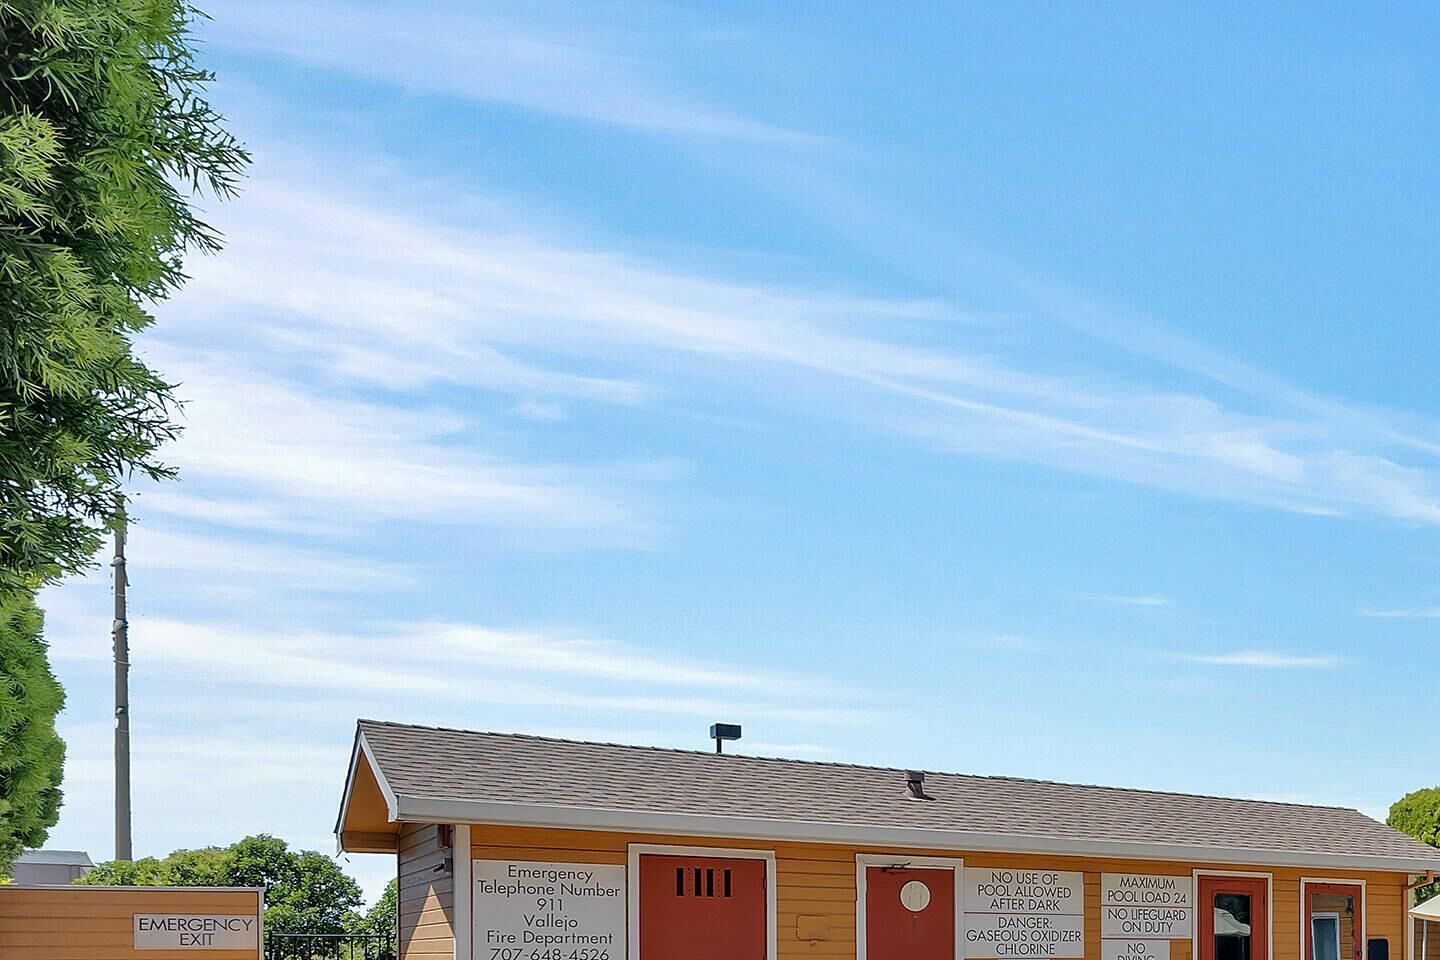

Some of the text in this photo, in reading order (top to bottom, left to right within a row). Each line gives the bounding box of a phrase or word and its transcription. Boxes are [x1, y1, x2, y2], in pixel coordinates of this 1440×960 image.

[508, 864, 593, 883] Emergency
[991, 872, 1058, 885] NO USE OF
[478, 880, 621, 897] Telephone Number
[1120, 877, 1175, 889] MAXIMUM
[978, 885, 1071, 898] POOL ALLOWED
[1108, 891, 1186, 903] POOL LOAD 24
[536, 898, 563, 911] 911
[990, 899, 1060, 911] AFTER DARK
[1108, 909, 1186, 921] NO LIFEGUARD
[139, 918, 252, 931] EMERGENCY
[524, 914, 578, 931] Vallejo
[999, 917, 1052, 929] DANGER:
[1122, 922, 1173, 933] ON DUTY
[180, 933, 215, 945] EXIT
[487, 930, 613, 946] Fire Department
[966, 930, 1081, 942] GASEOUS OXIDIZER
[996, 944, 1055, 955] CHLORINE
[1127, 943, 1146, 954] NO
